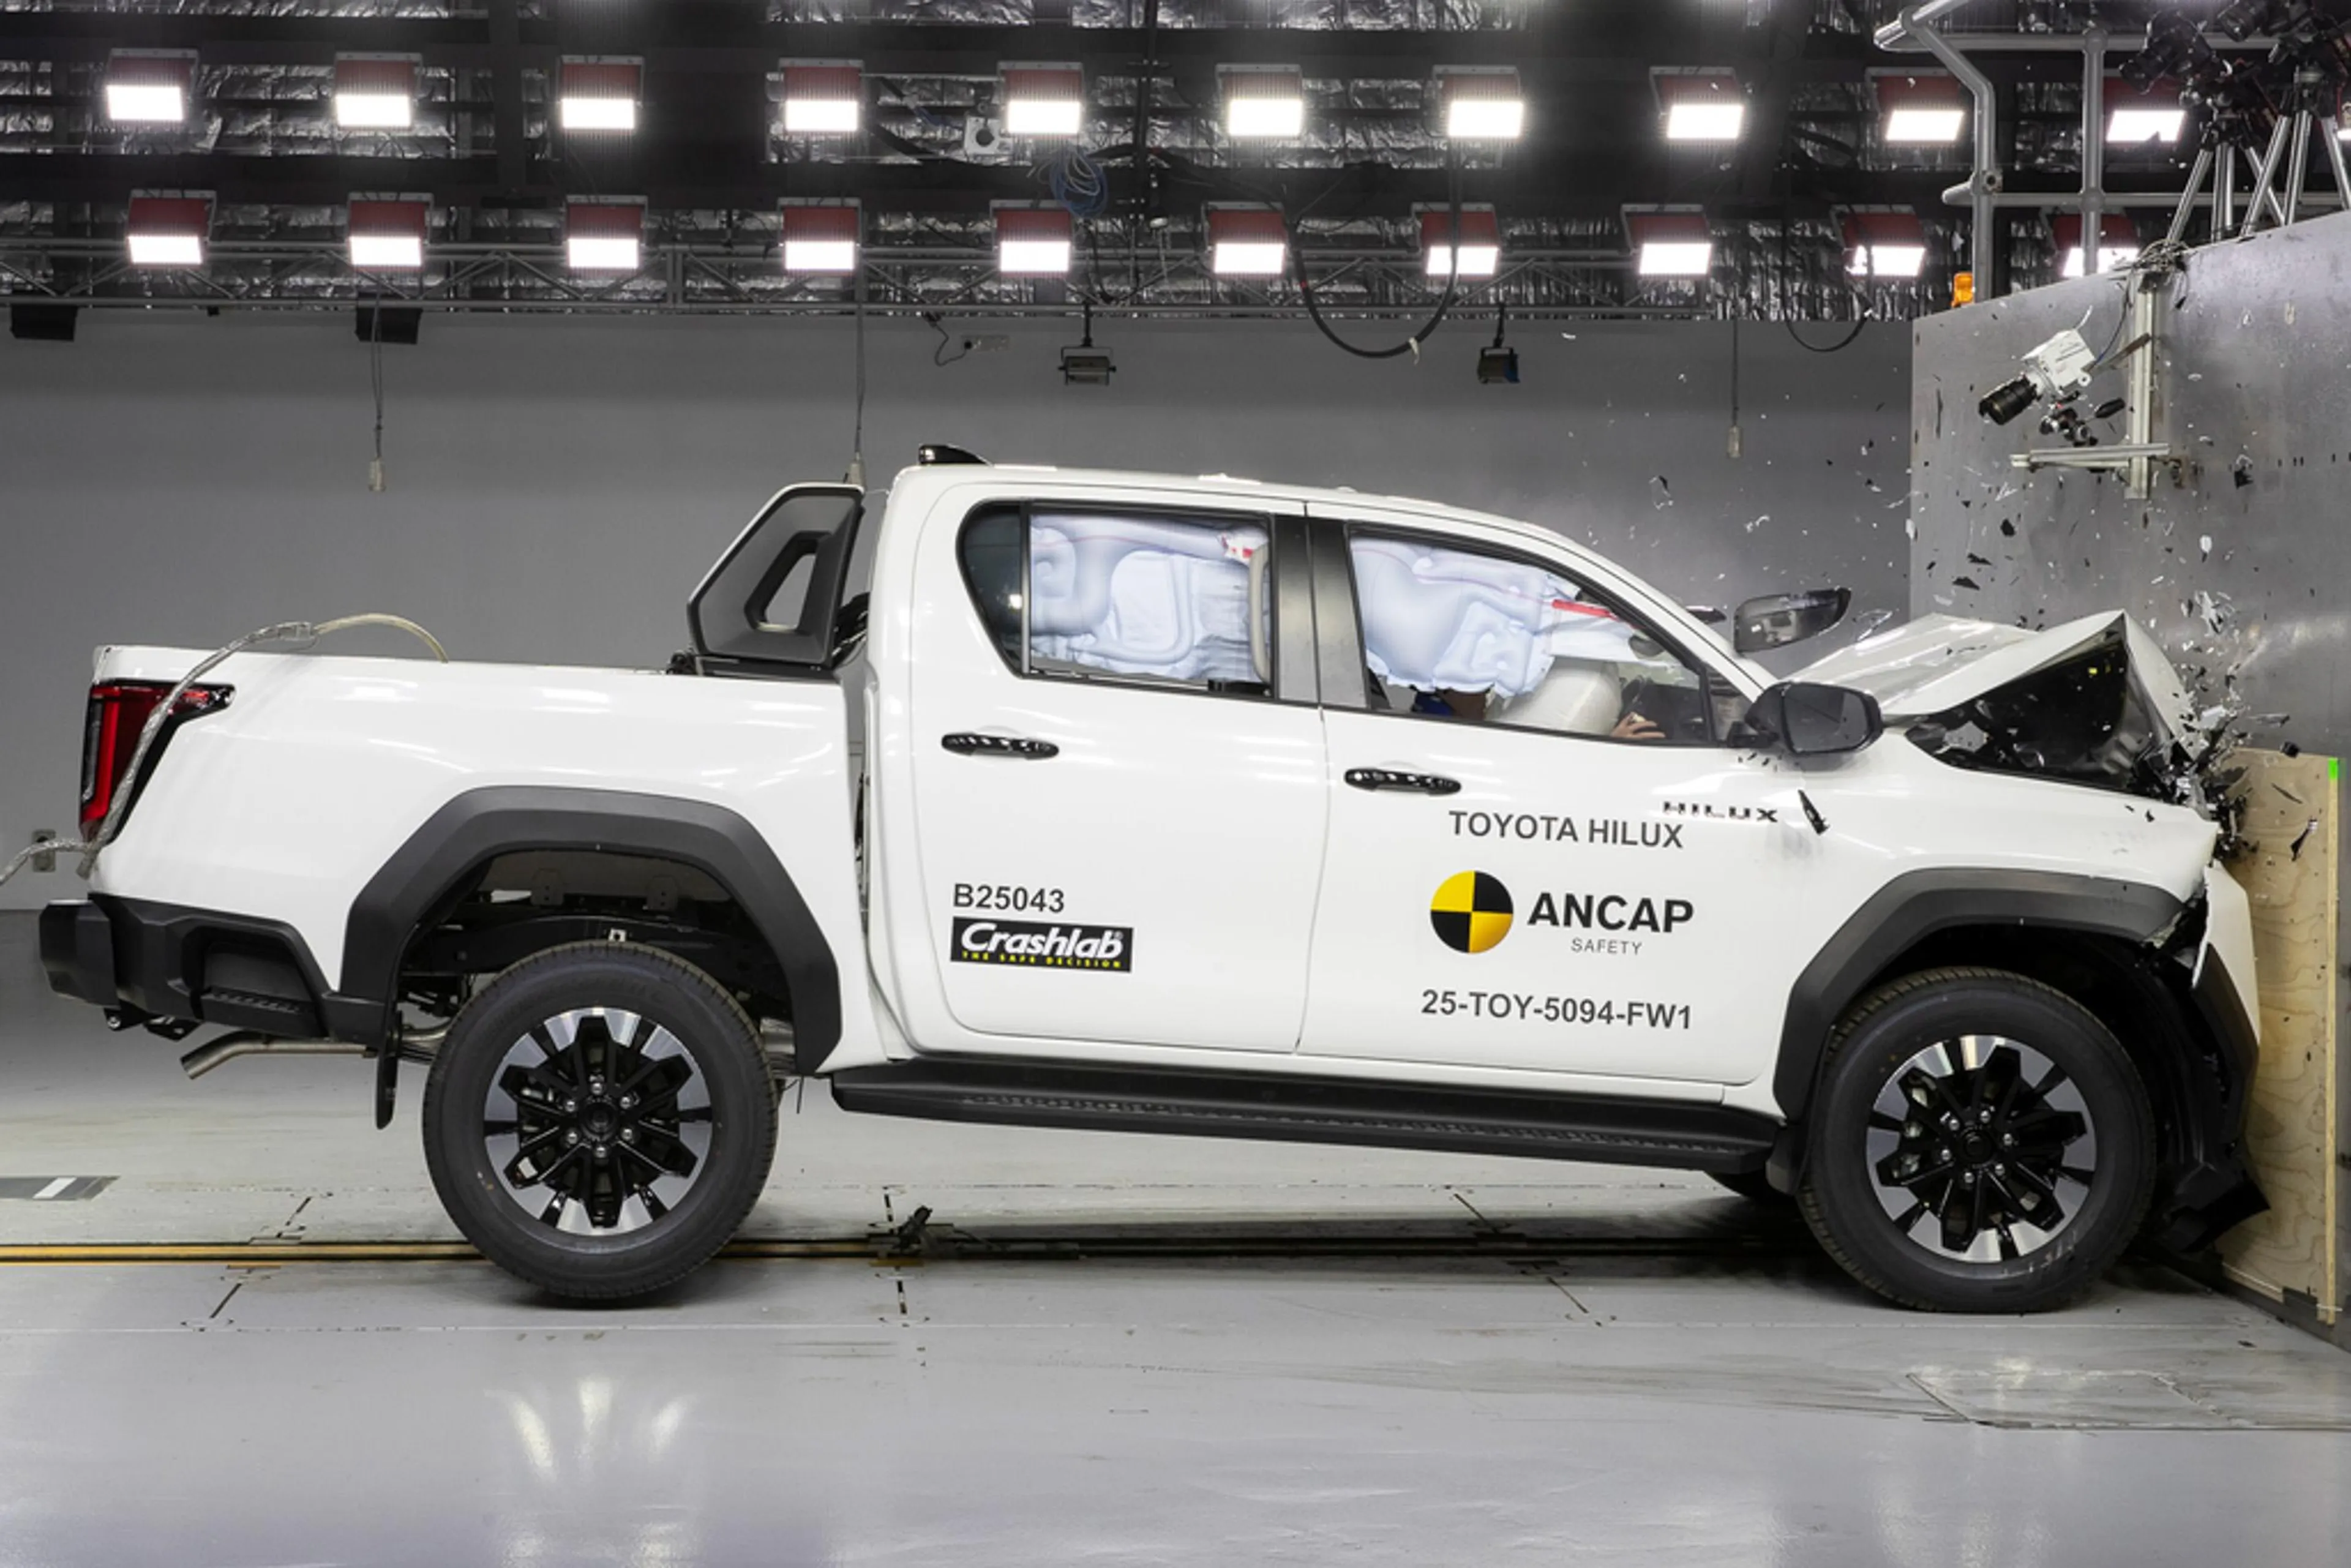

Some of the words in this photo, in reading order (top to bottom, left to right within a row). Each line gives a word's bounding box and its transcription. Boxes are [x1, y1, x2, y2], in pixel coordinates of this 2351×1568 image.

[1449, 811, 1578, 842] TOYOTA
[1588, 819, 1683, 849] HILUX
[1663, 801, 1778, 823] HILUX
[953, 883, 1065, 913] B25043
[1526, 892, 1694, 933] ANCAP
[961, 921, 1123, 959] Crashlab
[1571, 937, 1643, 955] SAFETY
[1421, 989, 1690, 1030] 25-TOY-5094-FW1
